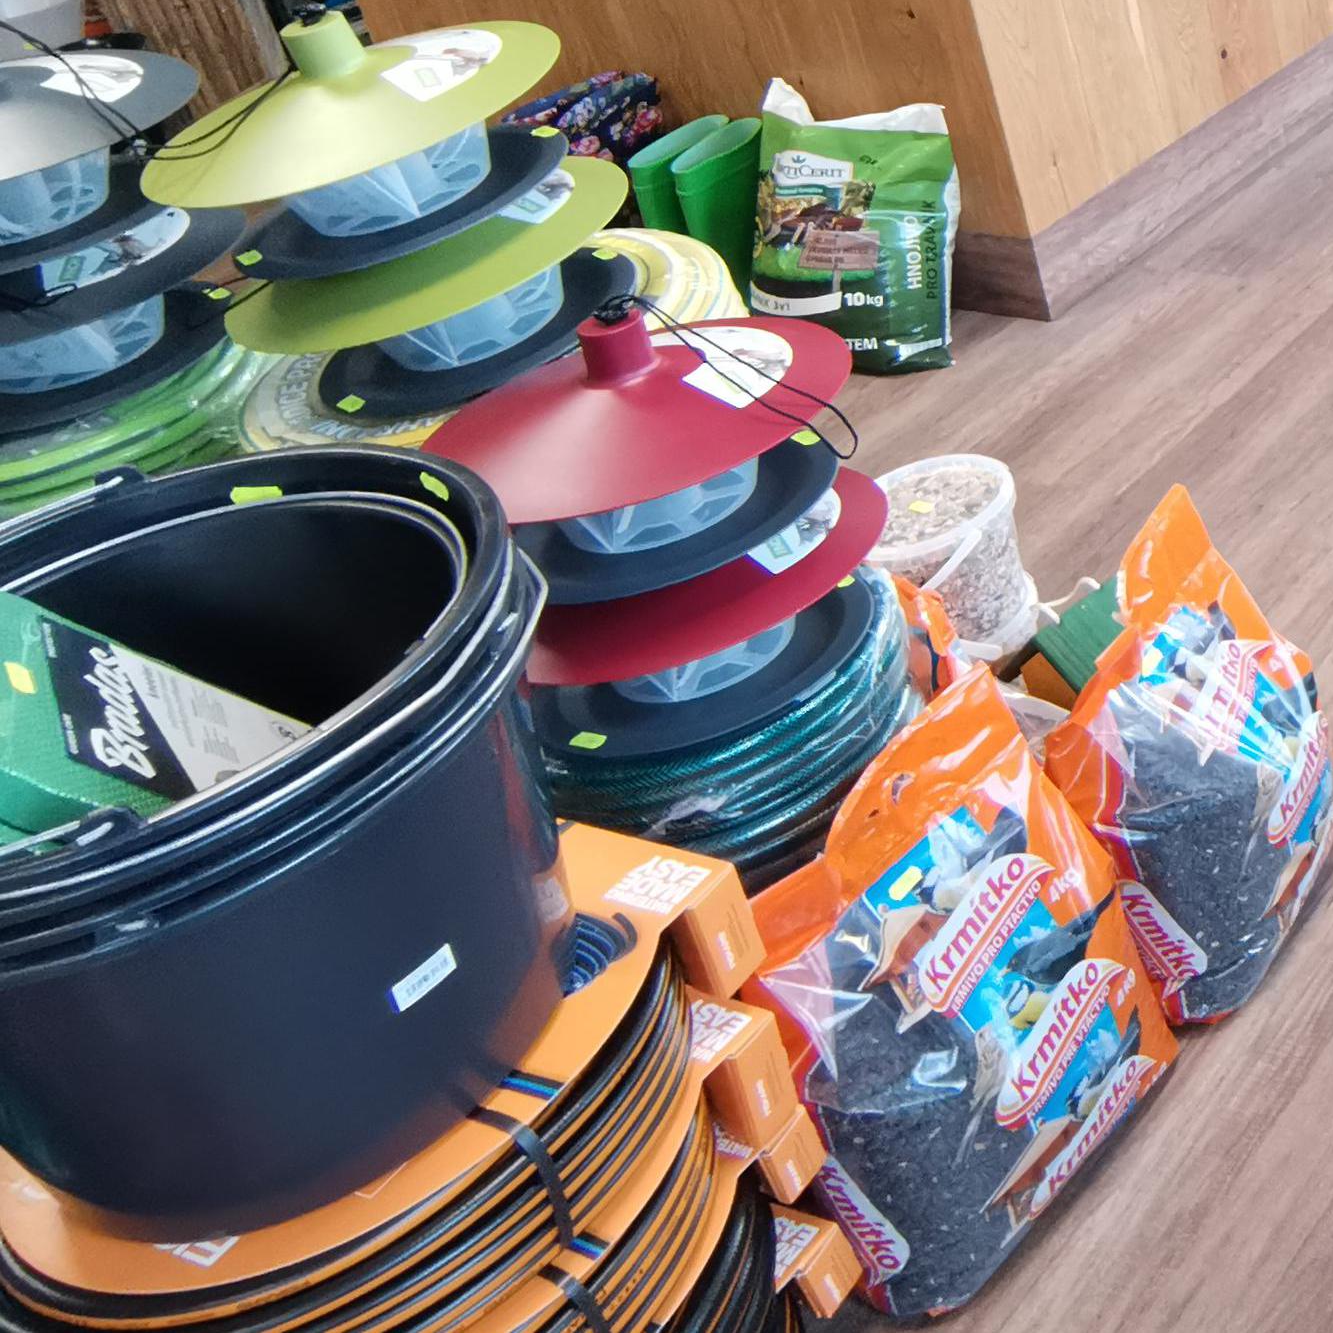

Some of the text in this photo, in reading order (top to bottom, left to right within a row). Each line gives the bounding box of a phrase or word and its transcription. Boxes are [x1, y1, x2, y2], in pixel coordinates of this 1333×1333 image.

[906, 215, 922, 291] HNOJIVO
[635, 856, 711, 893] EASY
[925, 854, 1028, 995] Krmítko
[1011, 961, 1100, 1104] Krmítko
